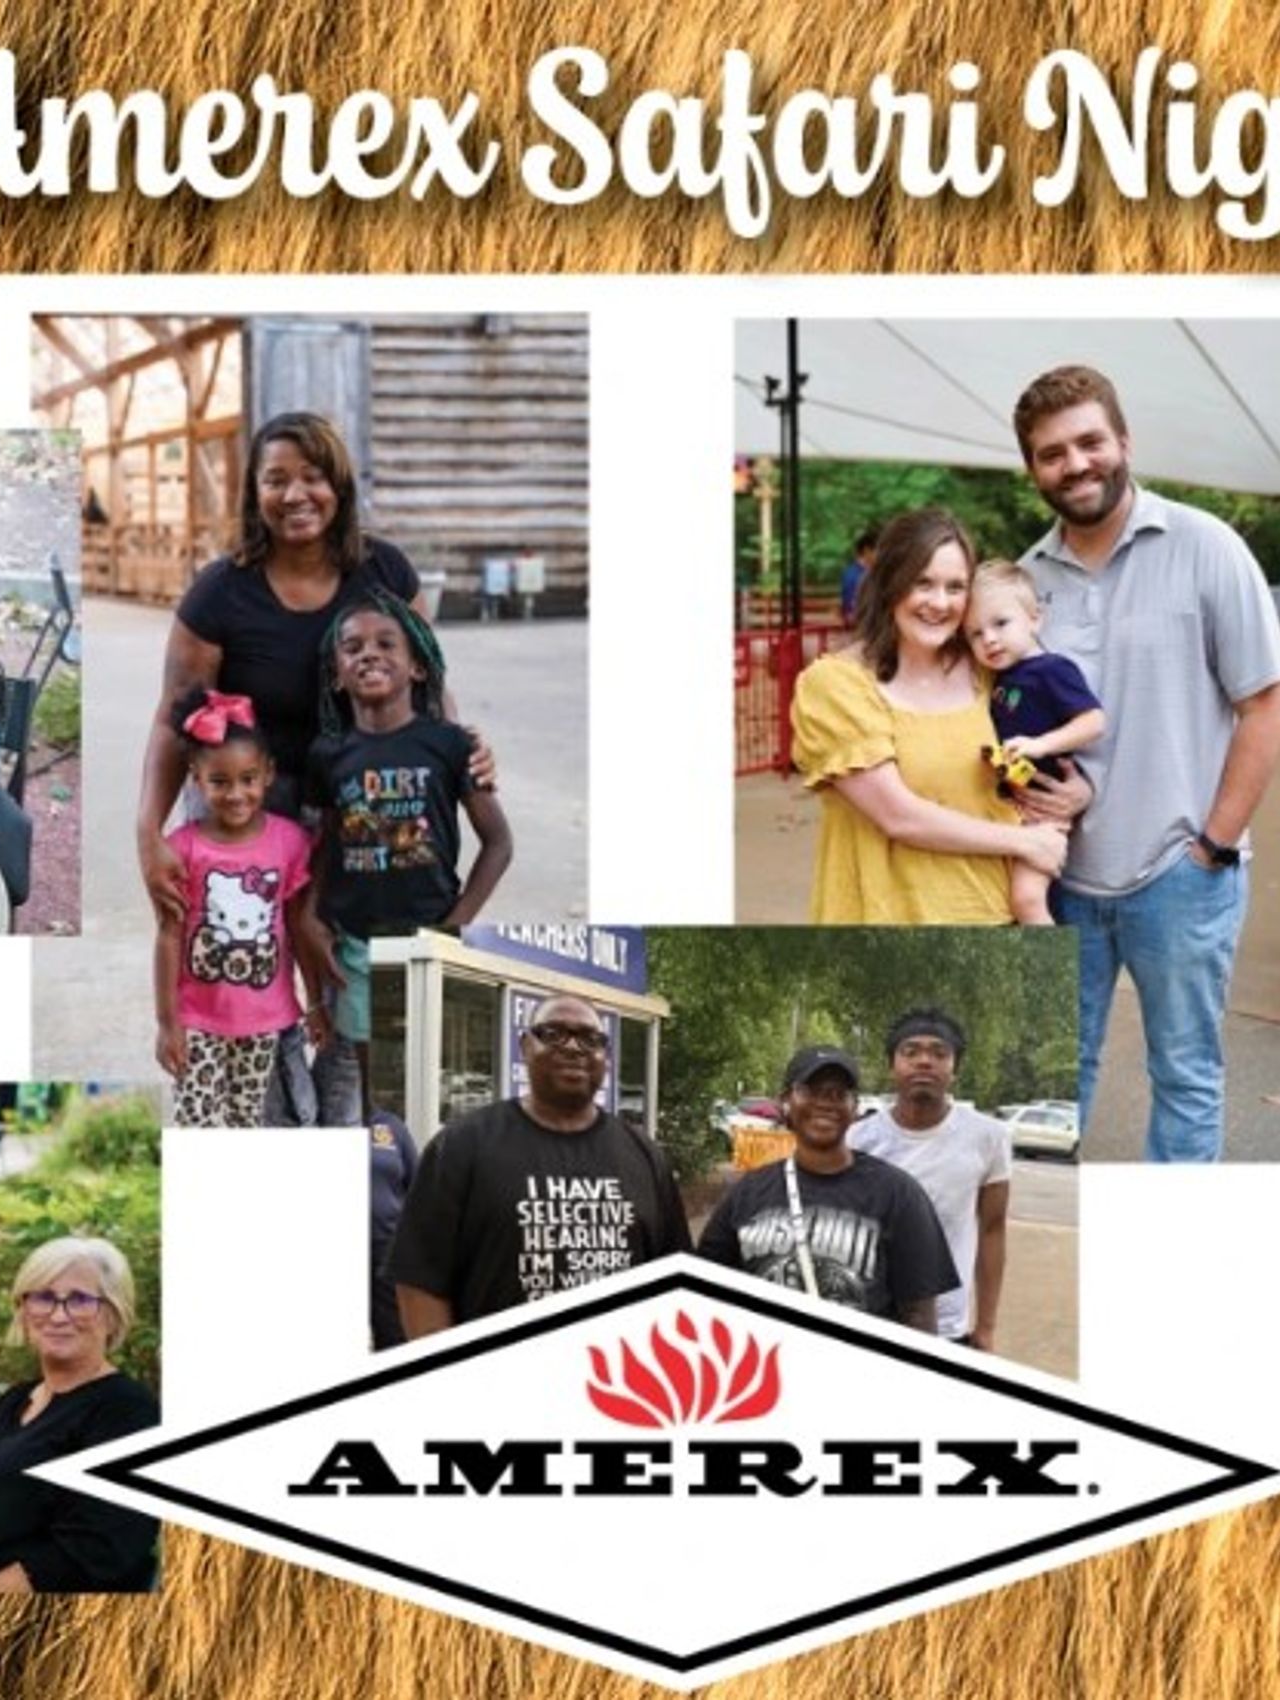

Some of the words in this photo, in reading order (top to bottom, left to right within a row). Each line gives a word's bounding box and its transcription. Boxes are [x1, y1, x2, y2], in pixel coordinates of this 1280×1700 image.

[527, 1176, 538, 1200] I
[546, 1176, 622, 1200] HAVE
[516, 1201, 635, 1226] SELECTIVE
[524, 1225, 628, 1251] HEARING
[566, 1249, 632, 1271] SORRY
[518, 1273, 554, 1291] YOU
